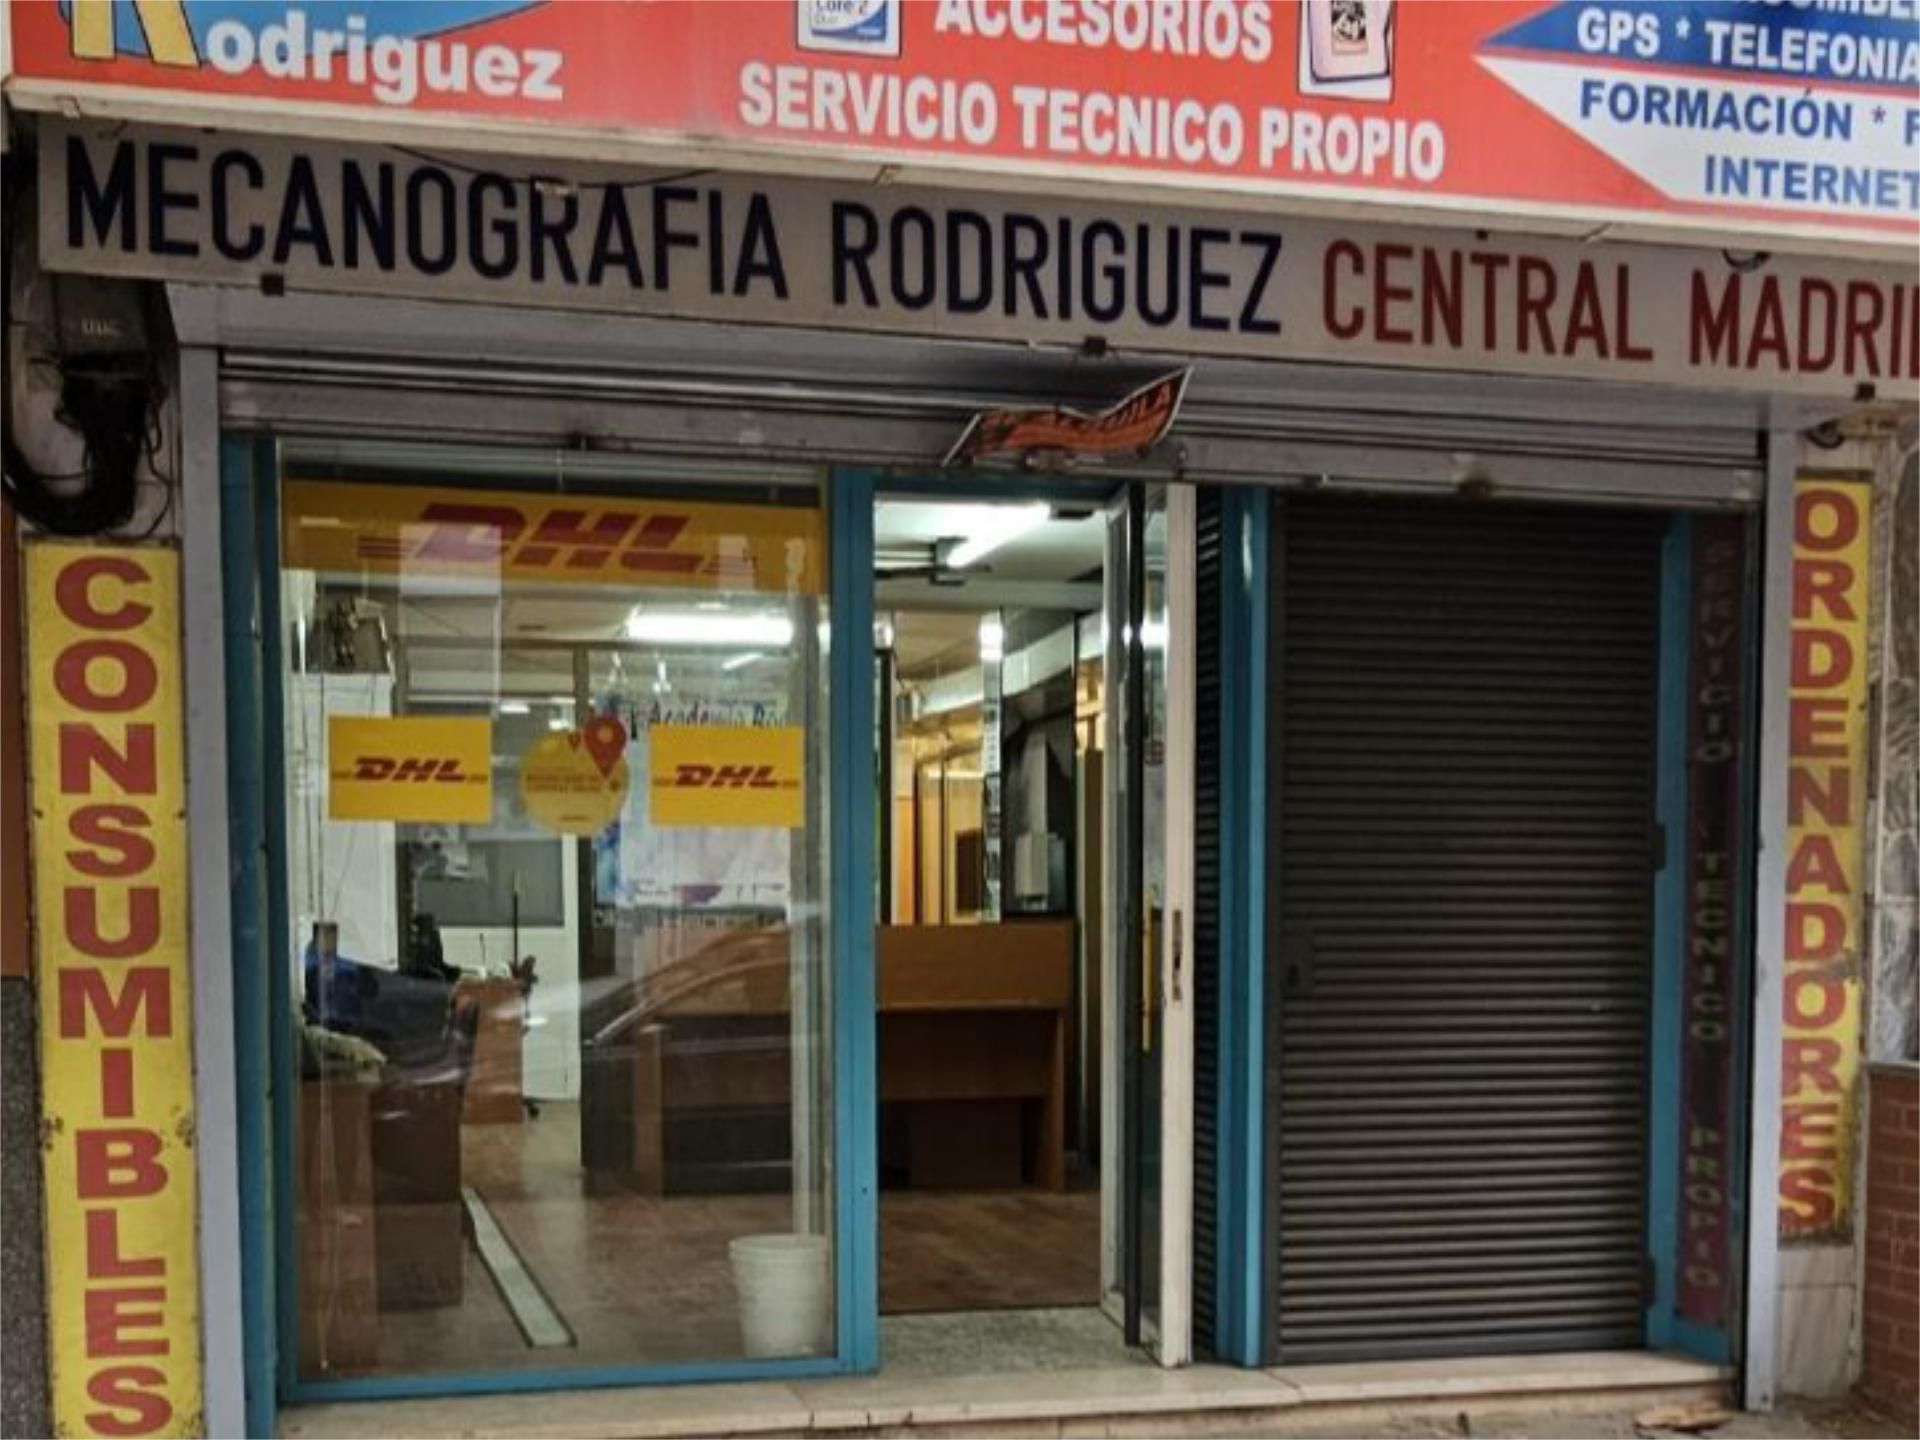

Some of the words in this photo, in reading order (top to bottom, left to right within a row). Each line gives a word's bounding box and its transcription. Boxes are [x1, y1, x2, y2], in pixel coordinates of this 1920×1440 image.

[934, 0, 1272, 62] ACCESORIOS
[1577, 10, 1660, 57] GPS
[1704, 19, 1920, 82] TELEFONIA
[739, 62, 997, 145] SERVICIO
[1012, 85, 1244, 166] TECNICO
[1259, 107, 1444, 182] PROPIO
[1580, 79, 1853, 141] FORMACIÓN
[1704, 155, 1920, 210] INTERNET
[66, 134, 788, 300] MECANOGRAFIA
[831, 200, 1282, 334] RODRIGUEZ
[1323, 239, 1652, 363] CENTRAL
[1689, 268, 1920, 379] MADRI
[413, 503, 704, 573] DHL
[354, 757, 466, 783] DHL
[676, 765, 778, 788] DHL
[1777, 489, 1859, 1231] ORDENADORES
[52, 555, 173, 1438] CONSUMIBLES
